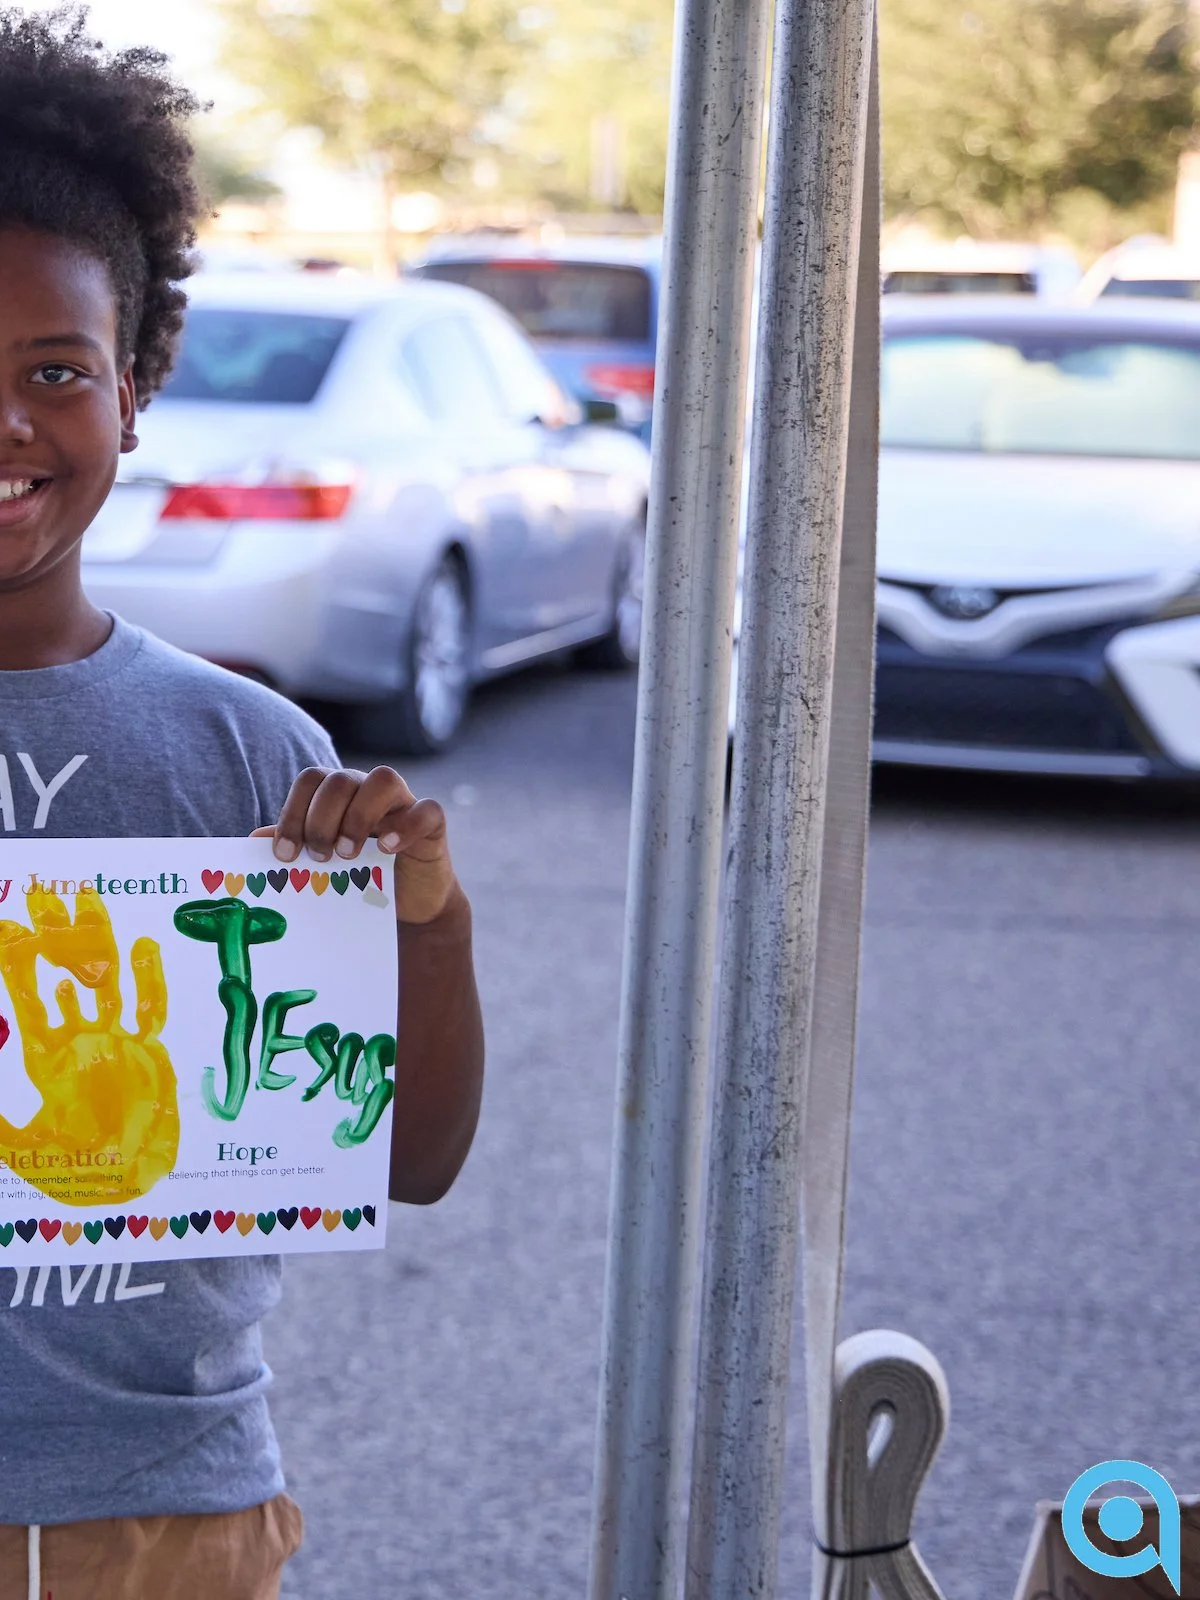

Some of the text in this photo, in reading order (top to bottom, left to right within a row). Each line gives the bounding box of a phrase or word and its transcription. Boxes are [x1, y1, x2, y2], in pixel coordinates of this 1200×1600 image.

[21, 872, 189, 896] Juneteenth
[216, 1142, 278, 1166] Hope
[11, 1177, 21, 1185] to
[23, 1174, 73, 1185] remember
[168, 1165, 326, 1180] Believing that things can get better.
[7, 1189, 27, 1199] with
[28, 1189, 46, 1200] joy,
